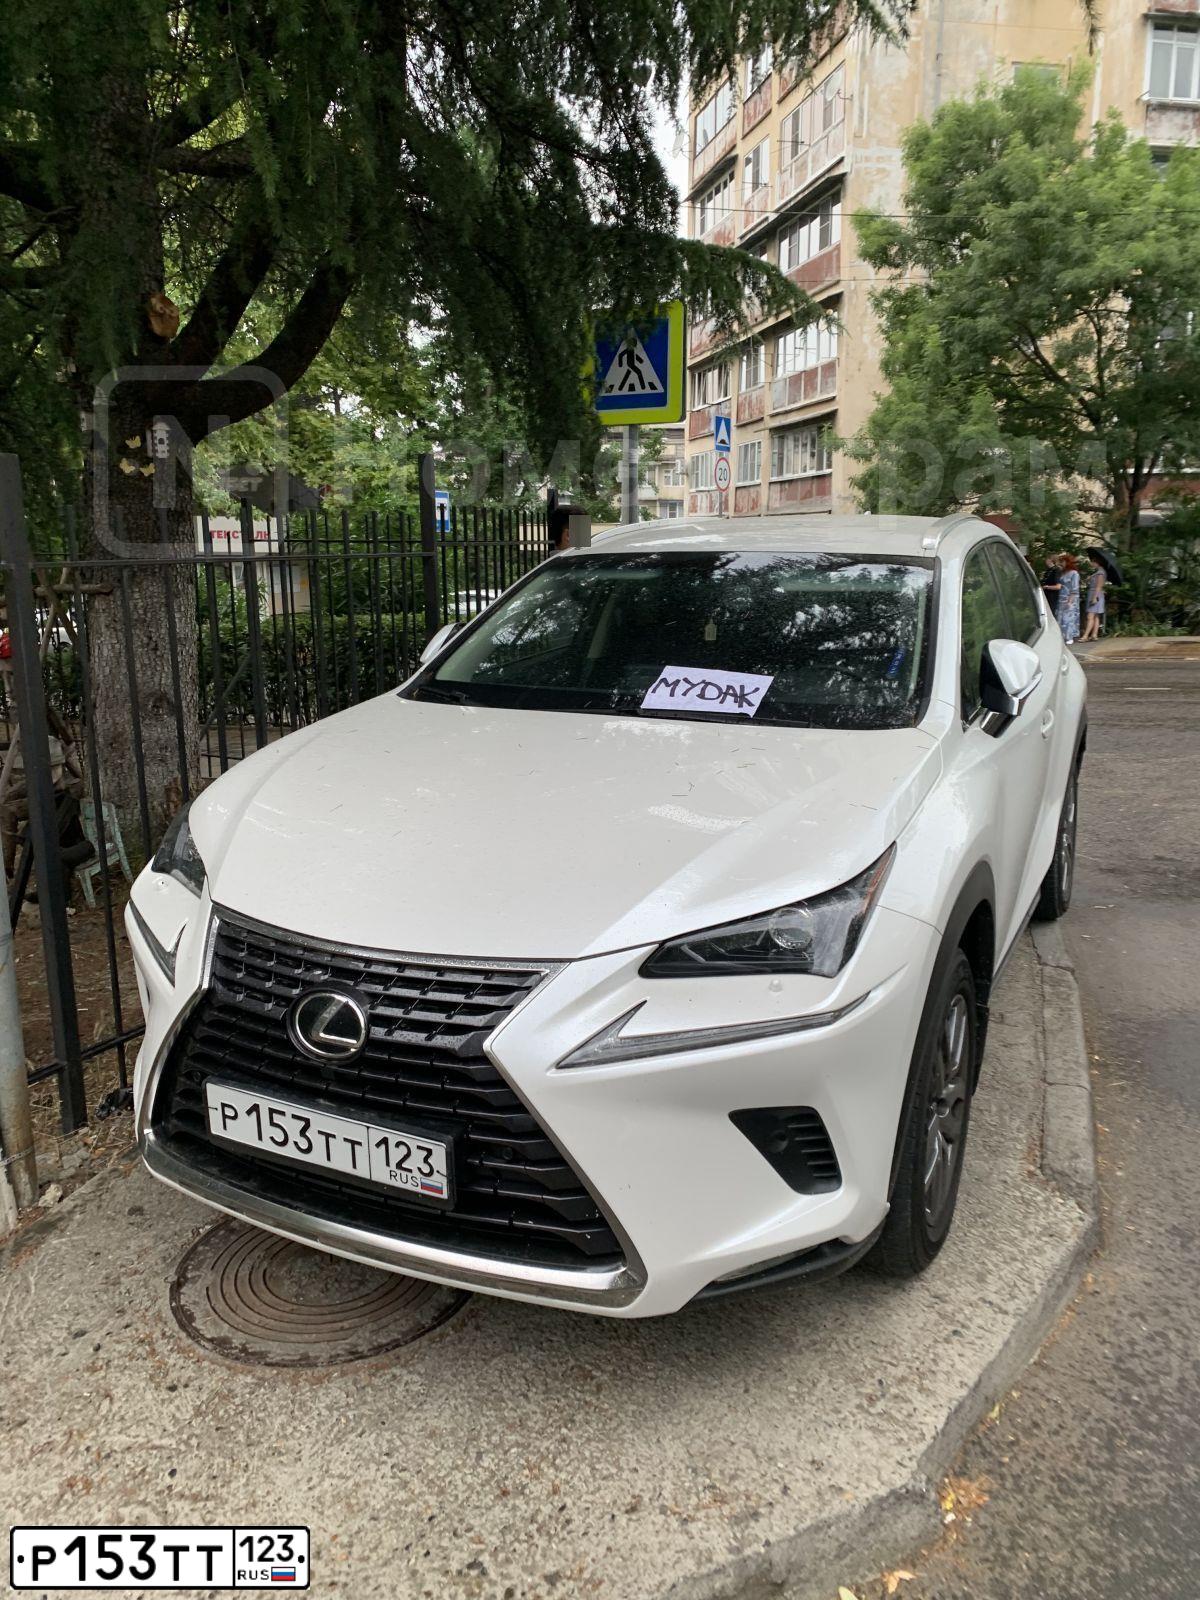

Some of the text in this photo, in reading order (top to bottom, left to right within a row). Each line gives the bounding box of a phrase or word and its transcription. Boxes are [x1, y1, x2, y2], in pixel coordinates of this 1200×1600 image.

[718, 466, 728, 482] 20
[374, 1136, 434, 1178] 123
[389, 1169, 419, 1188] RUS
